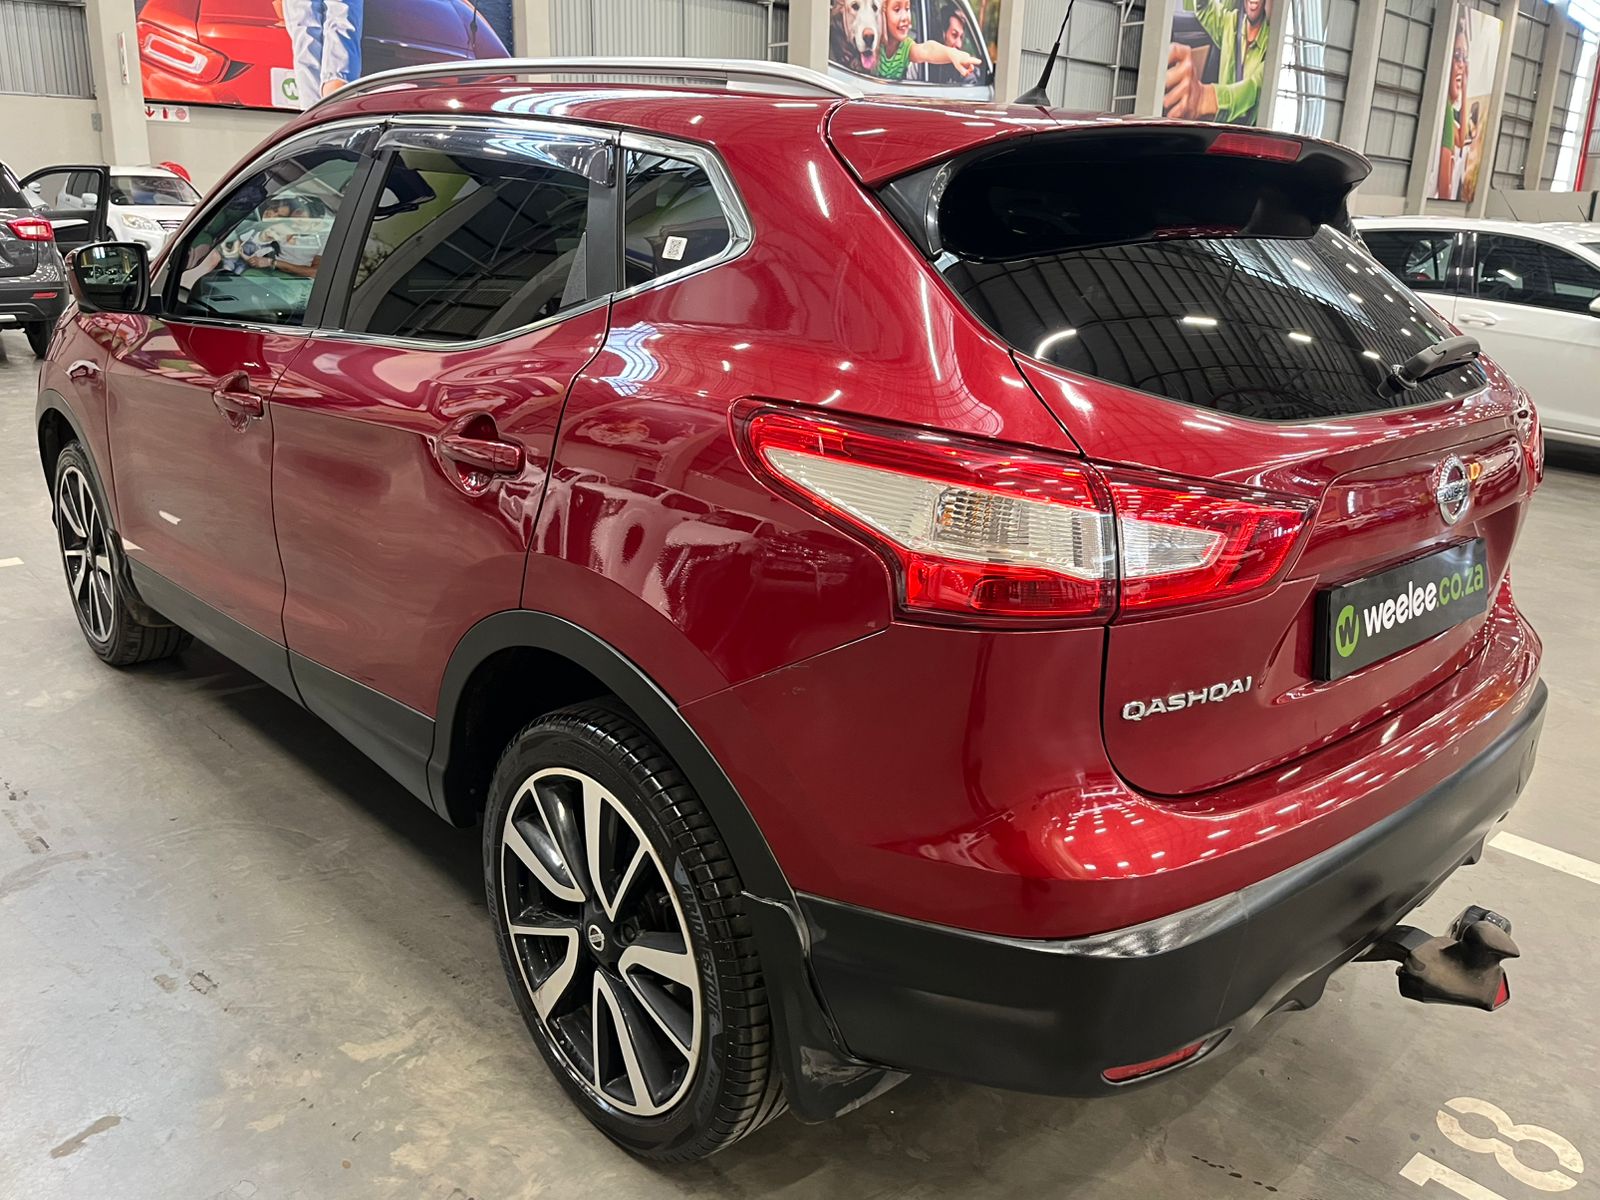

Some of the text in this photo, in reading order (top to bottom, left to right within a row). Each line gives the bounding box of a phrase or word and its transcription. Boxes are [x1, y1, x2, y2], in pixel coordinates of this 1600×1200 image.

[1363, 563, 1485, 637] weelee.co.za
[1122, 676, 1252, 721] QASHQAI
[1398, 1096, 1585, 1200] 18
